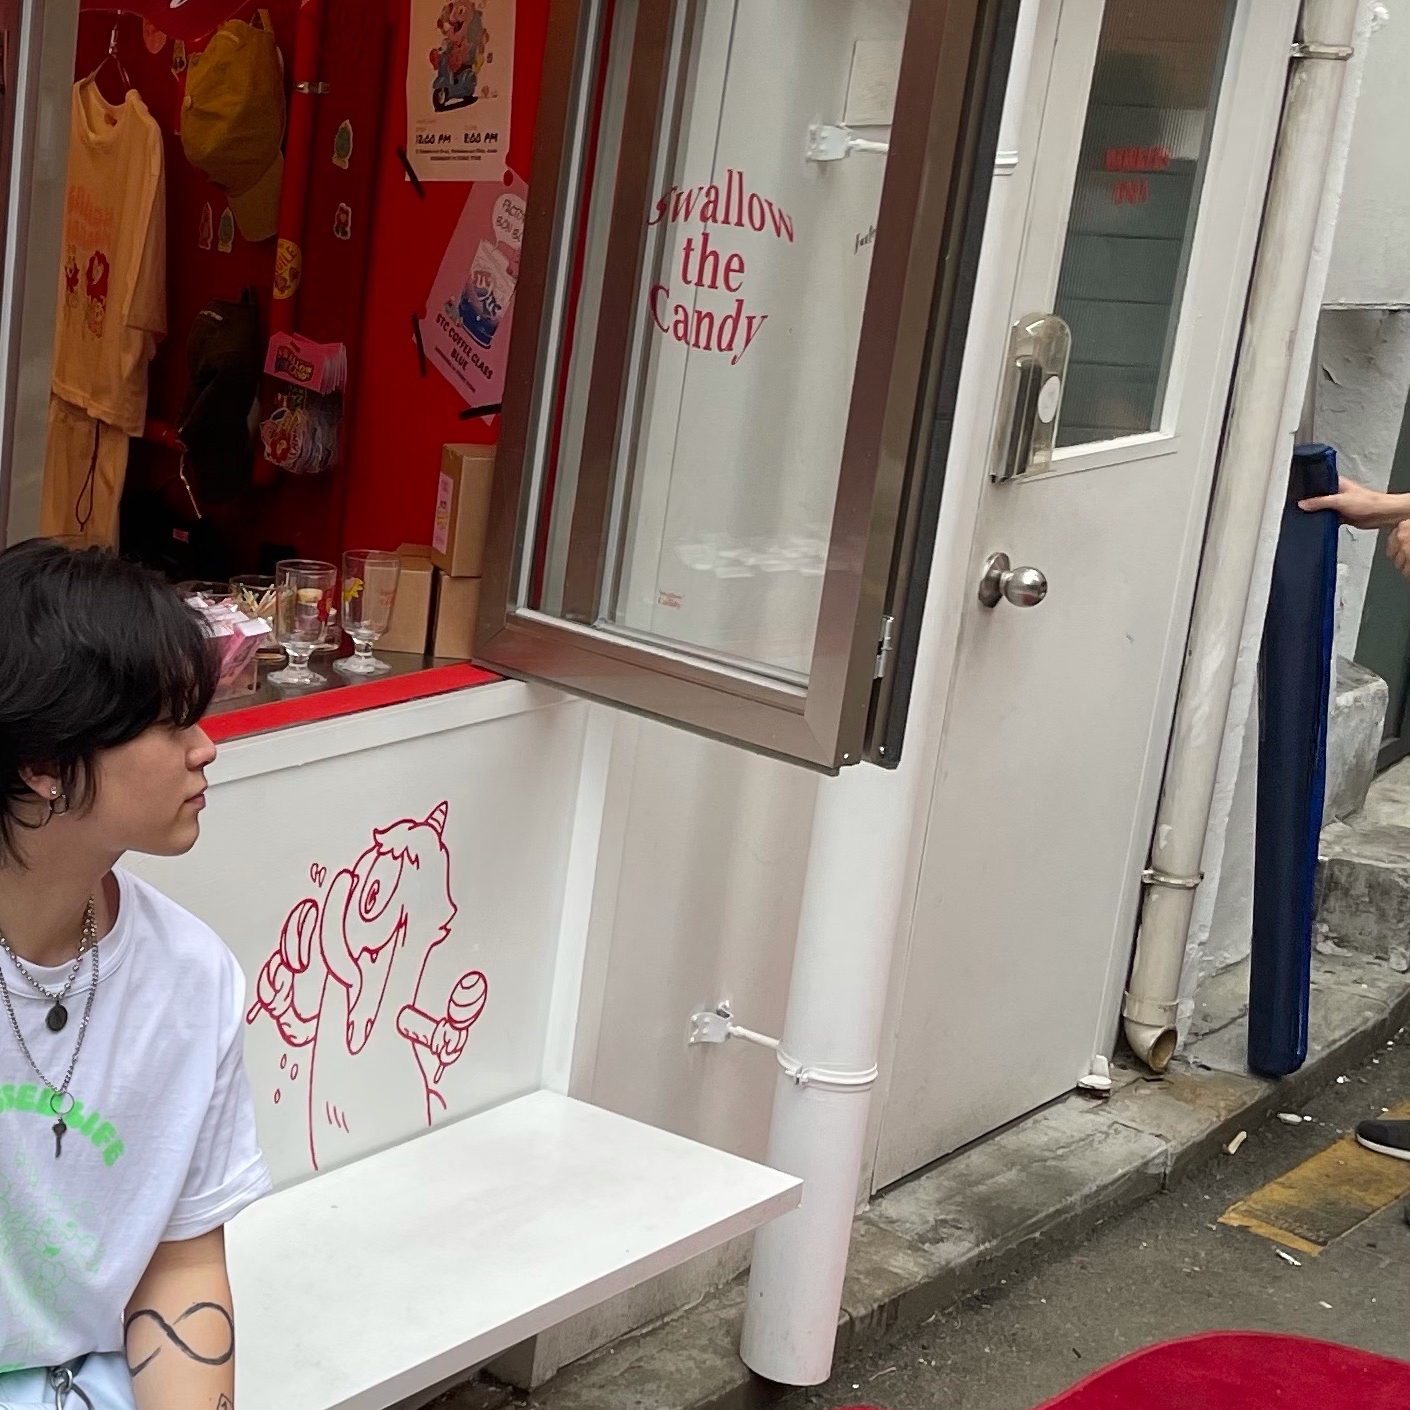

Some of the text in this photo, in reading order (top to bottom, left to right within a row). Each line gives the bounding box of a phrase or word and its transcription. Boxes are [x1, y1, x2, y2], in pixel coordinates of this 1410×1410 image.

[681, 232, 745, 293] the
[650, 284, 768, 365] Candy
[450, 348, 469, 371] BLUE
